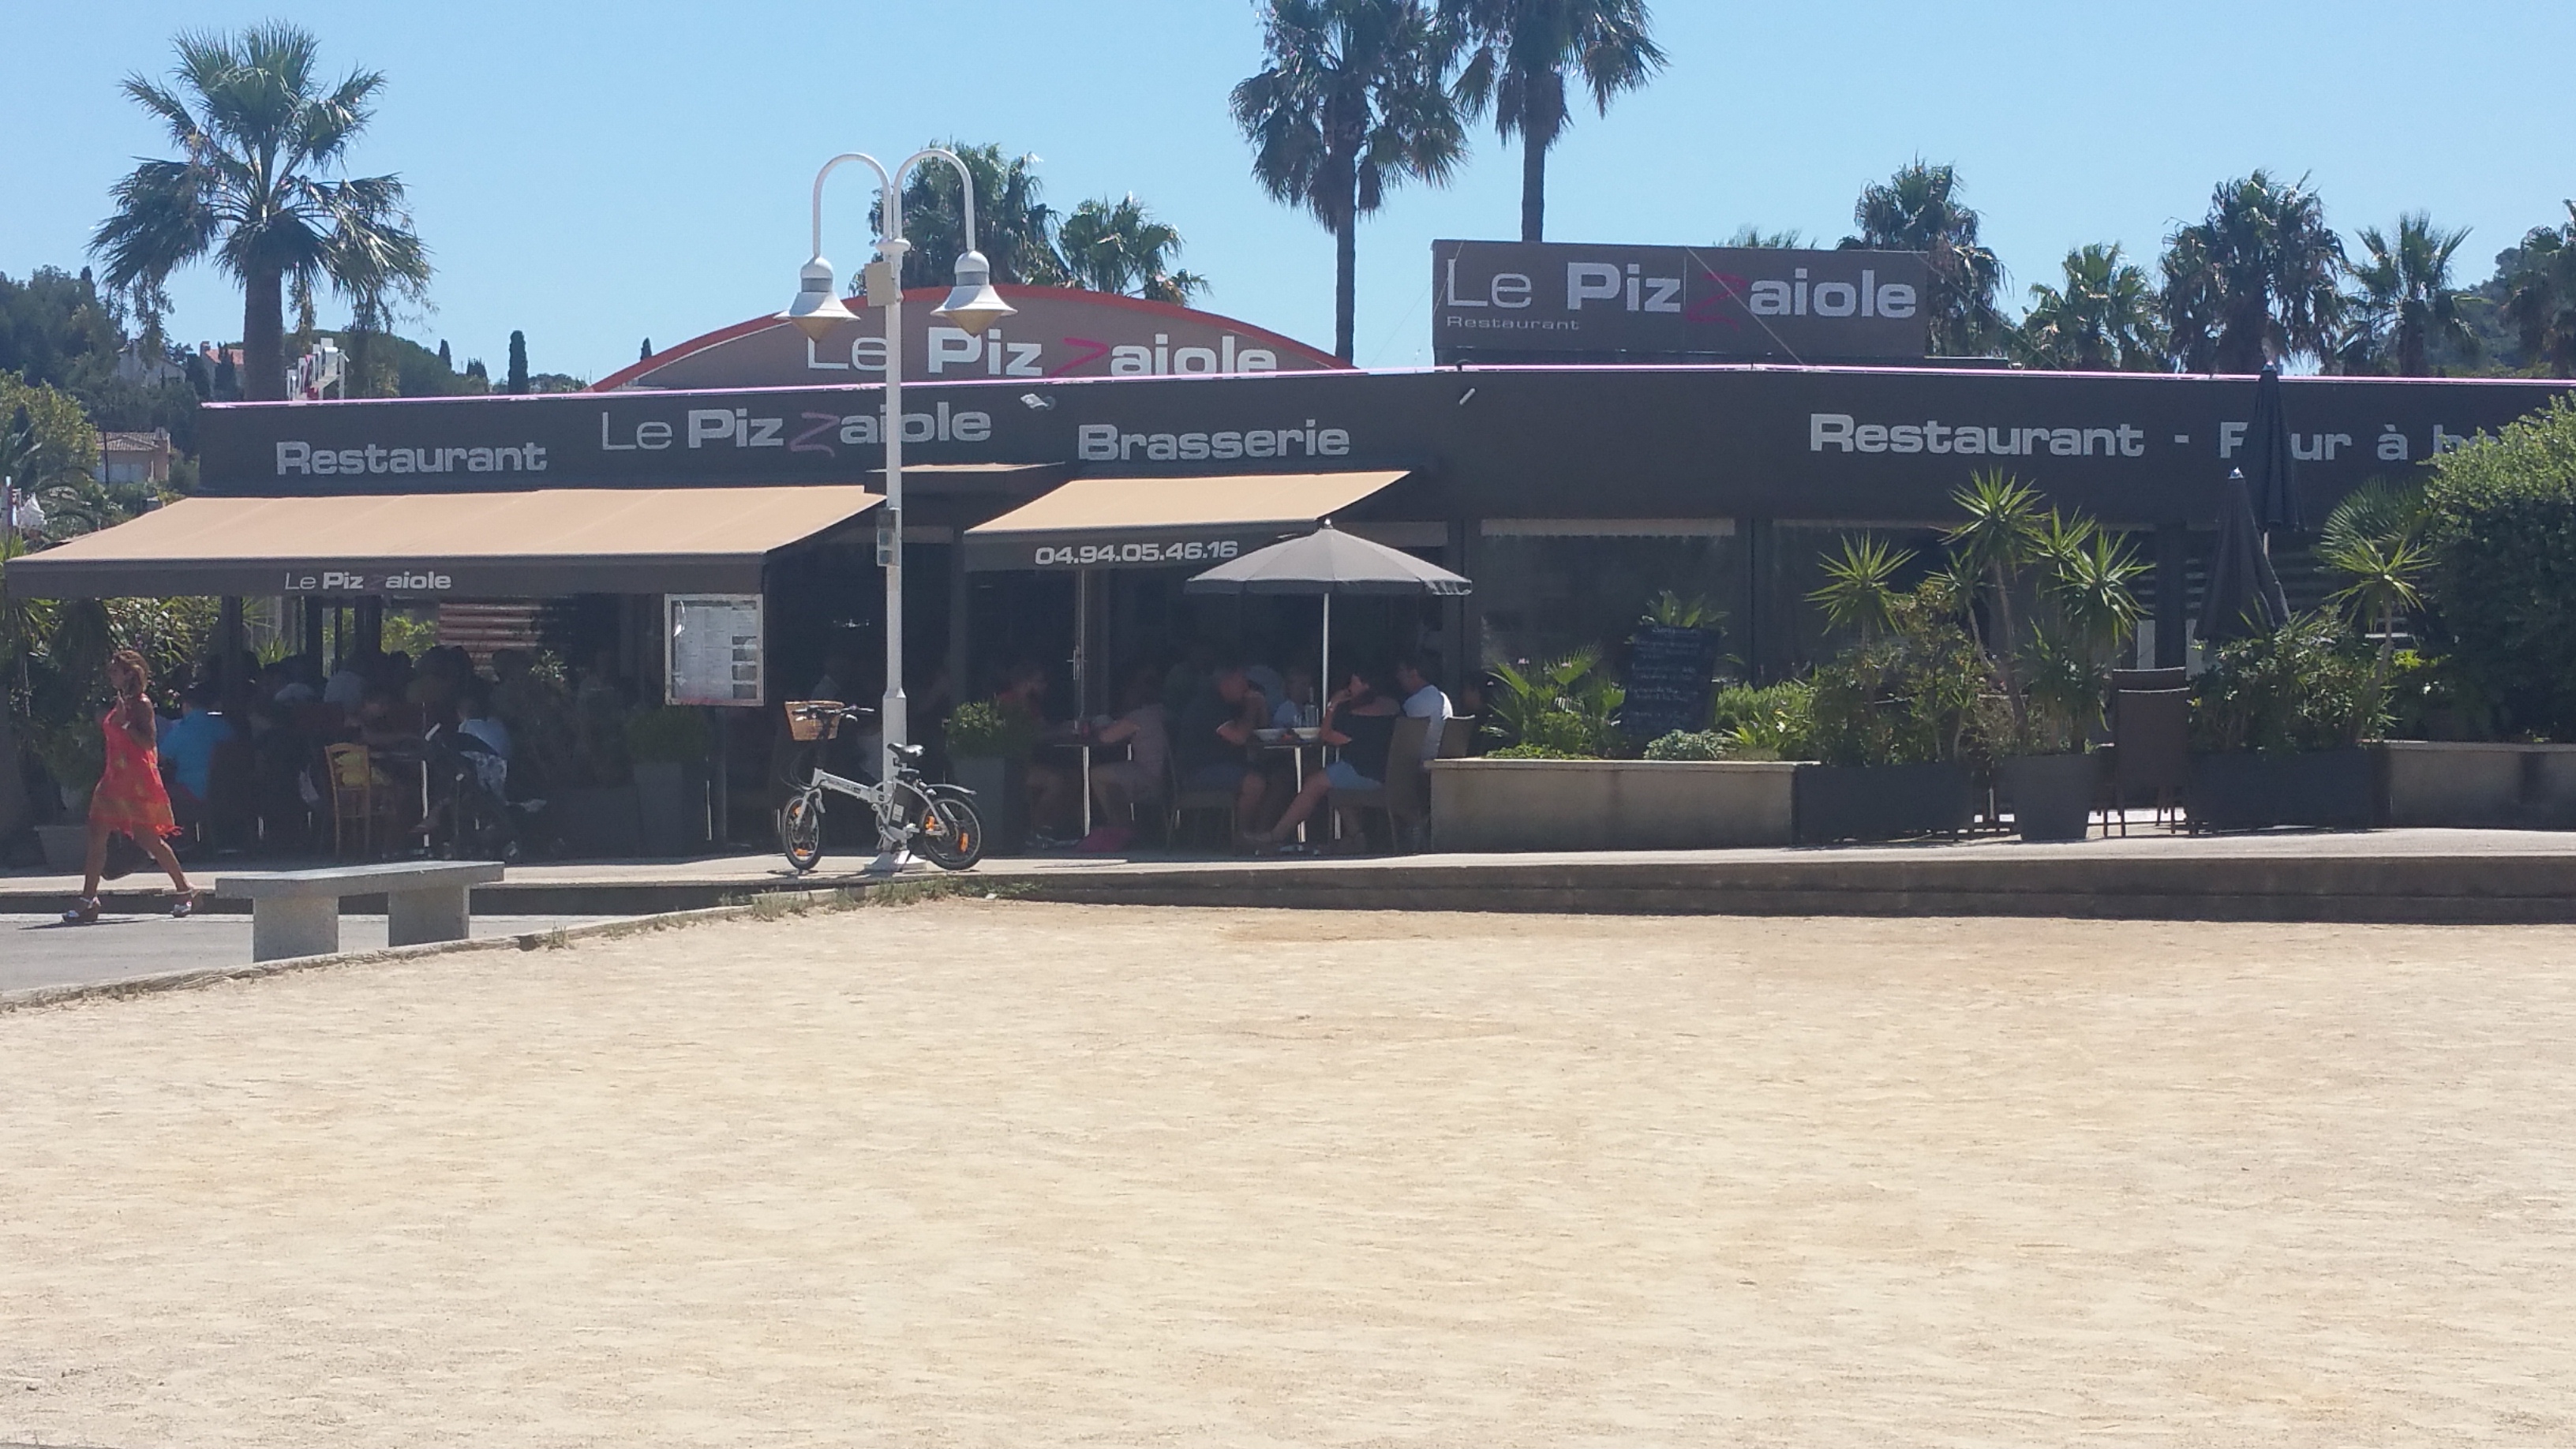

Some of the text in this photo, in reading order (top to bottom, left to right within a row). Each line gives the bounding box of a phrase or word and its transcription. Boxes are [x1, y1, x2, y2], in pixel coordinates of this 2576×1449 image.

[1447, 258, 1533, 309] Le
[1446, 316, 1580, 331] Restaurant
[807, 335, 888, 371] Le
[601, 411, 672, 451] Le
[1077, 418, 1350, 462] Brasserie
[1809, 413, 2145, 458] Restaurant
[2219, 421, 2353, 461] Fur
[2377, 424, 2408, 460] à
[275, 440, 549, 475] Restaurant
[1034, 540, 1238, 566] 04.94.05.46.16
[285, 571, 317, 590] Le
